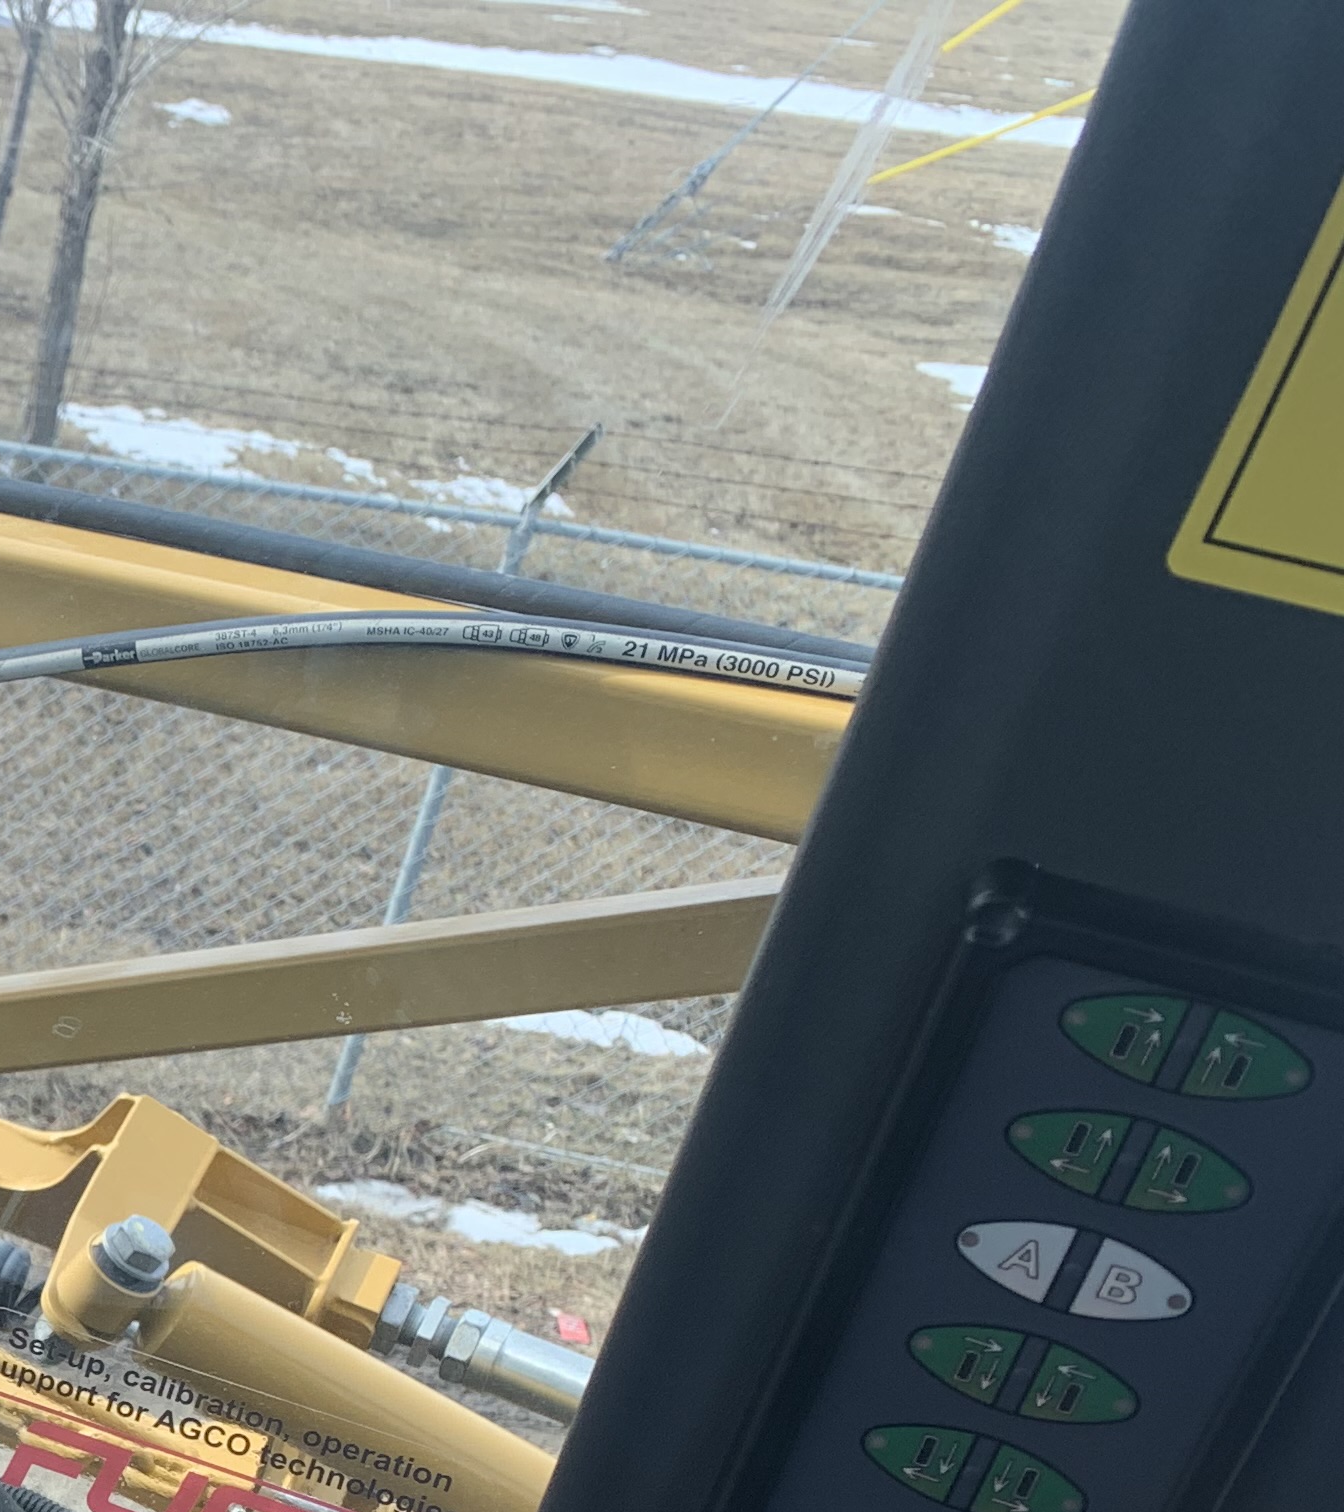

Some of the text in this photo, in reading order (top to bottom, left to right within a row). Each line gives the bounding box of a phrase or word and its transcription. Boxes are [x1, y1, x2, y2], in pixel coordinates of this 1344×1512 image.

[215, 641, 235, 651] ISO
[366, 627, 401, 636] MSHA
[91, 648, 136, 664] Parker
[621, 640, 836, 689] 21 MPa (3000 PSI)
[997, 1238, 1041, 1279] A
[1094, 1264, 1142, 1304] B
[8, 1326, 454, 1493] Set-up, calibration, operation
[106, 1392, 150, 1425] for
[153, 1411, 252, 1457] AGCO
